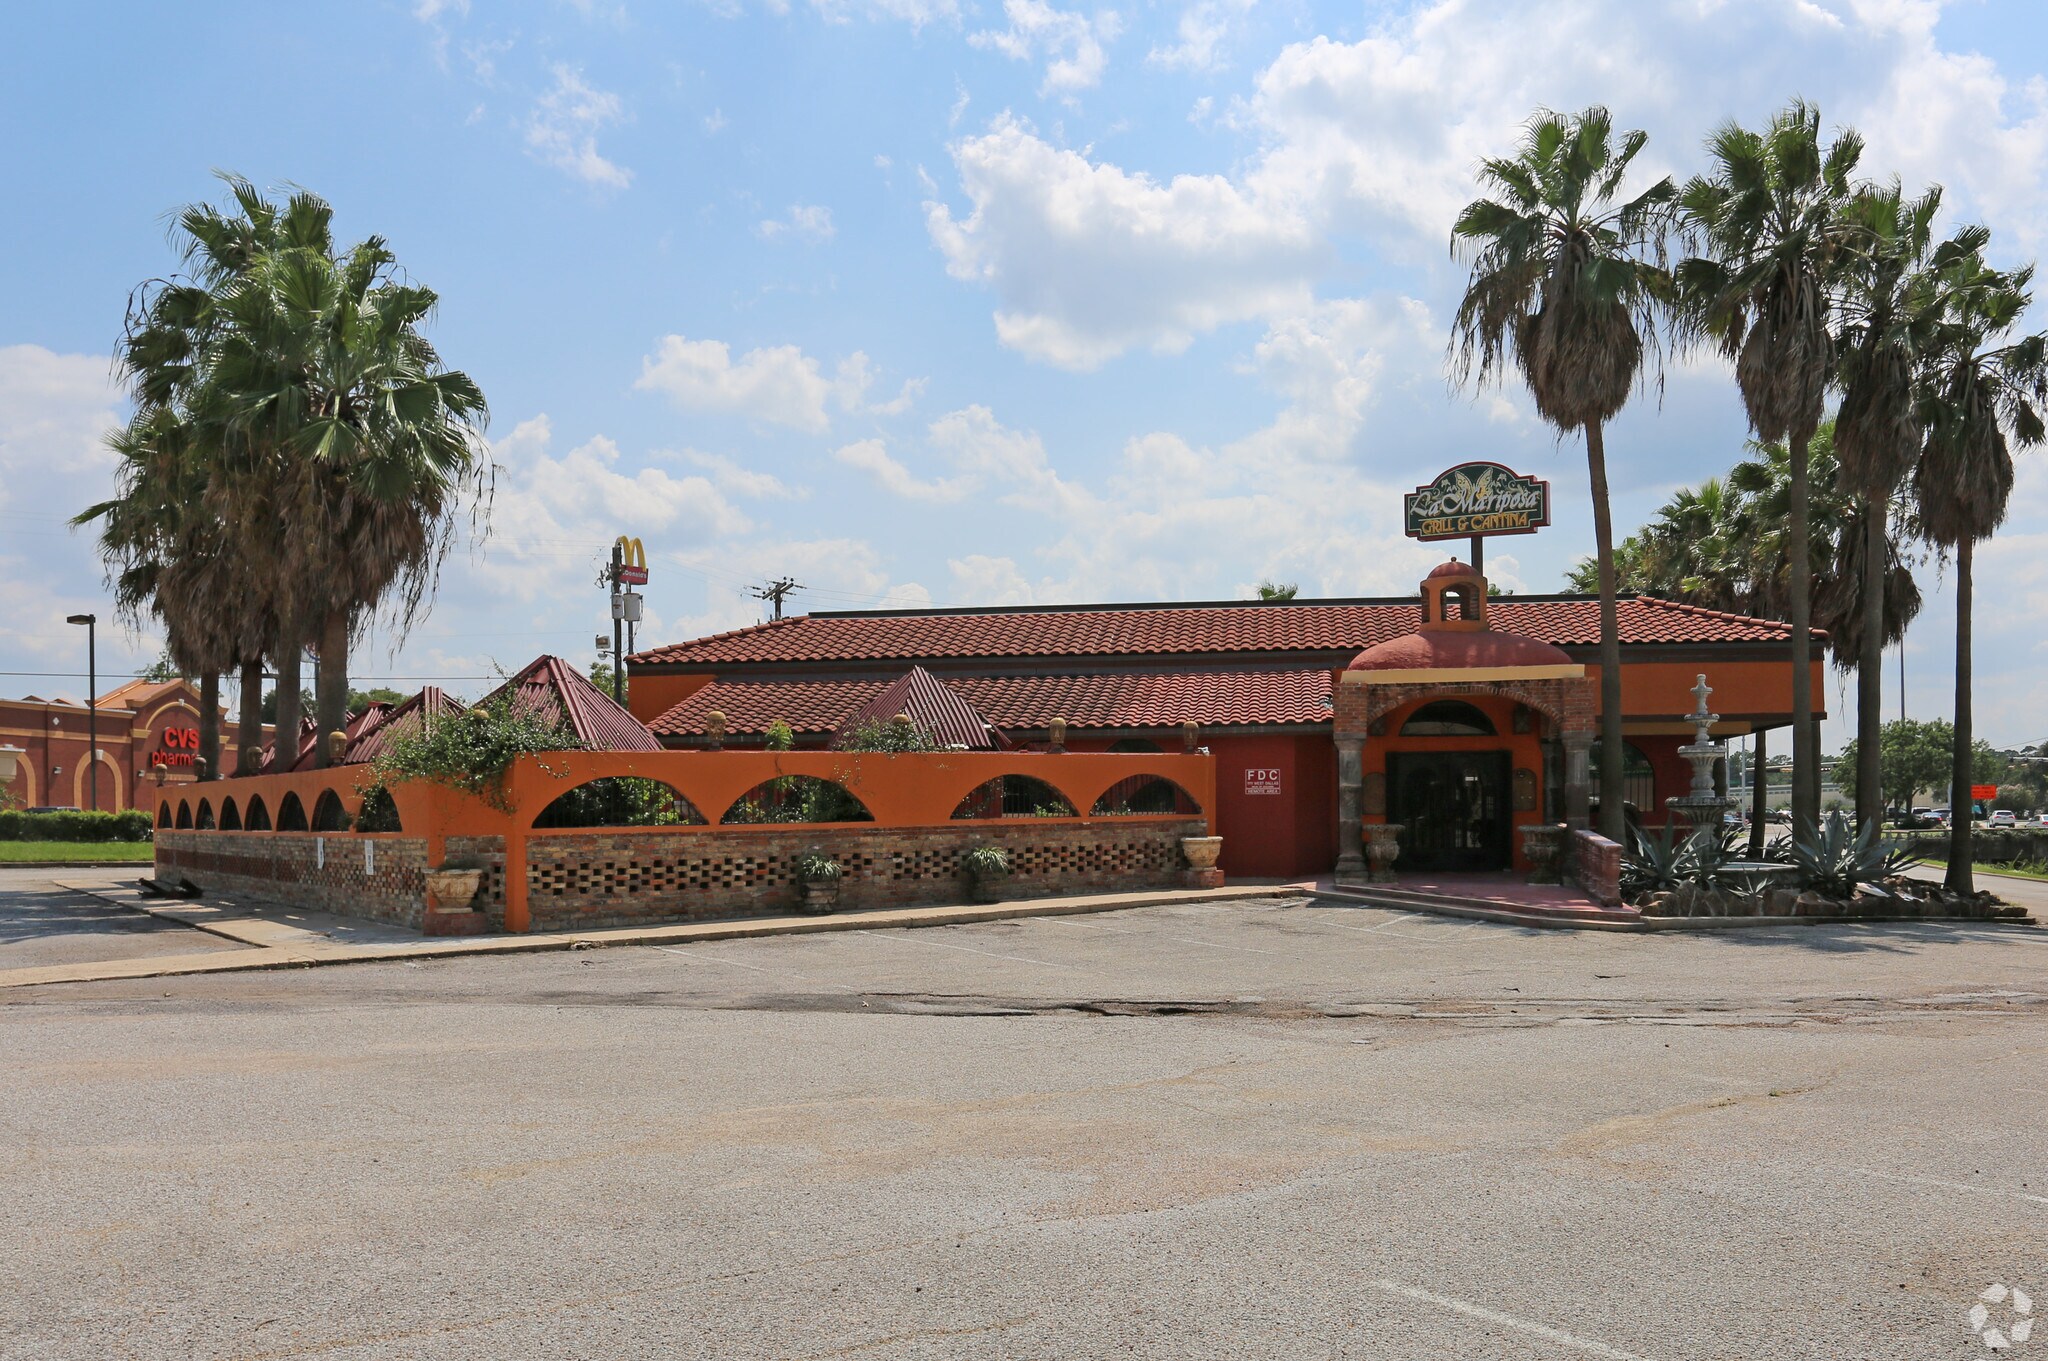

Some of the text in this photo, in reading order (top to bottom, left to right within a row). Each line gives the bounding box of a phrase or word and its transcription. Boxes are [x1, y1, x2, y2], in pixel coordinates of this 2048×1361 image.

[1410, 486, 1539, 517] La Mariposa
[1422, 512, 1528, 534] GRILL & CANTINA
[165, 727, 200, 748] CVS
